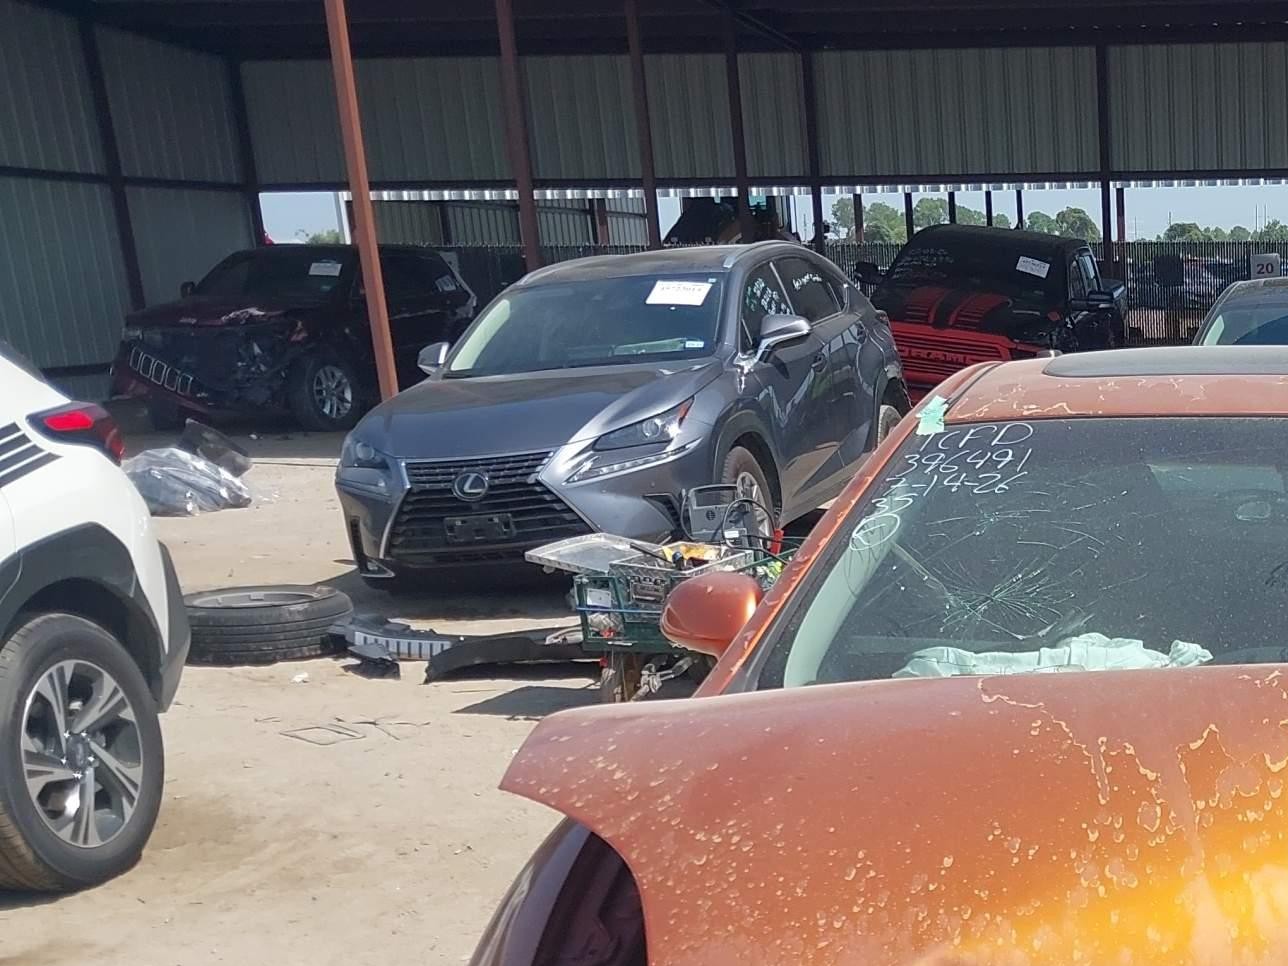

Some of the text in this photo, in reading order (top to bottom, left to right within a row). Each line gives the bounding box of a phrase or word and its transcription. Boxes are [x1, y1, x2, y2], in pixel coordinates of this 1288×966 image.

[1256, 262, 1274, 275] 20
[896, 448, 1033, 477] 396491
[882, 471, 1028, 497] 7-14-26
